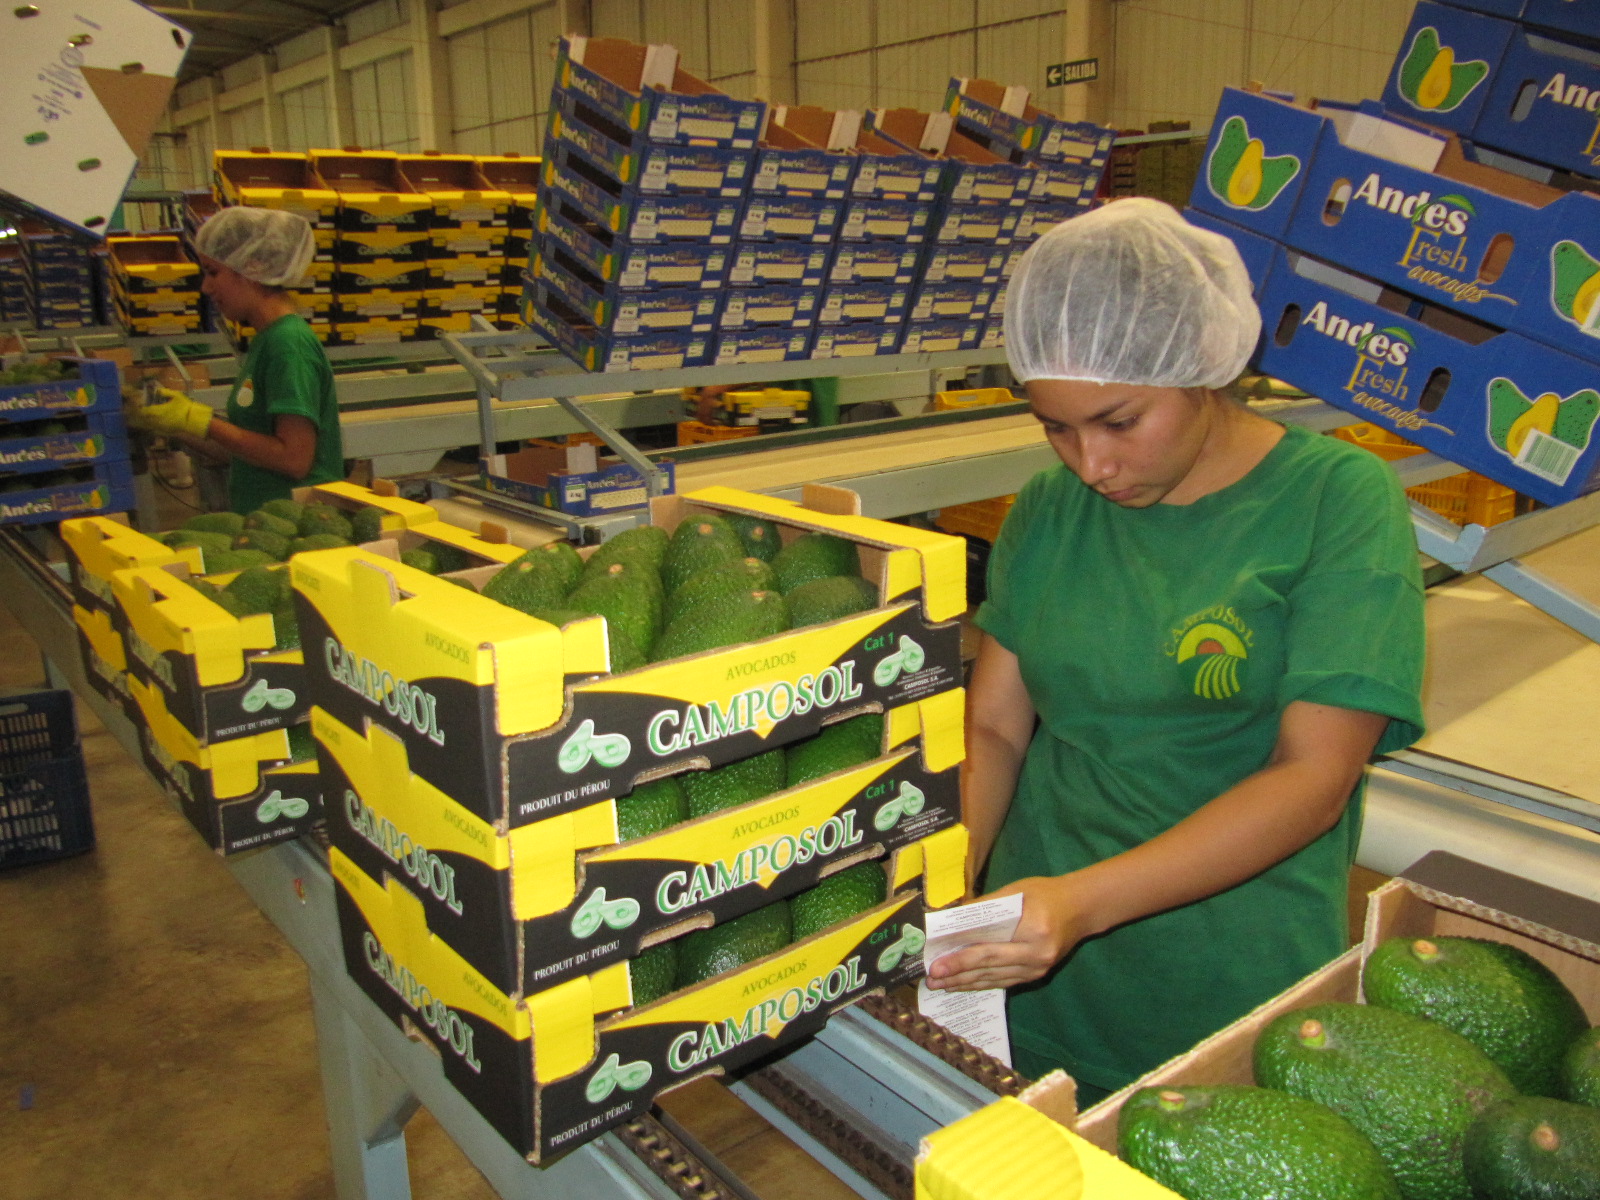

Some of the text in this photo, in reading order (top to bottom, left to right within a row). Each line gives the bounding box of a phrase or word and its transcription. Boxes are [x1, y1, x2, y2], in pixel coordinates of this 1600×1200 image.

[1064, 61, 1097, 83] SALIDA
[1353, 173, 1469, 236] Andes
[1397, 226, 1469, 272] Fresh
[1408, 265, 1517, 306] avocados
[1302, 301, 1410, 366] Andes
[1344, 353, 1410, 402] Fresh
[1352, 391, 1455, 436] avocados
[864, 632, 895, 651] Cat 1
[726, 651, 797, 681] AVOCADOS
[325, 637, 446, 746] CAMPOSOL
[648, 659, 864, 757] CAMPOSOL
[520, 779, 611, 816] PRODUIT DU PÉROU
[866, 779, 895, 799] Cat 1
[732, 805, 801, 840] AVOCADOS
[344, 789, 464, 917] CAMPOSOL
[657, 808, 865, 915] CAMPOSOL
[869, 923, 898, 945] Cat 1
[534, 957, 574, 981] PRODUIT
[575, 952, 590, 965] DU
[742, 959, 808, 998] AVOCADOS
[363, 931, 482, 1074] CAMPOSOL
[668, 955, 867, 1073] CAMPOSOL
[550, 1121, 590, 1147] PRODUIT
[591, 1114, 604, 1129] DU
